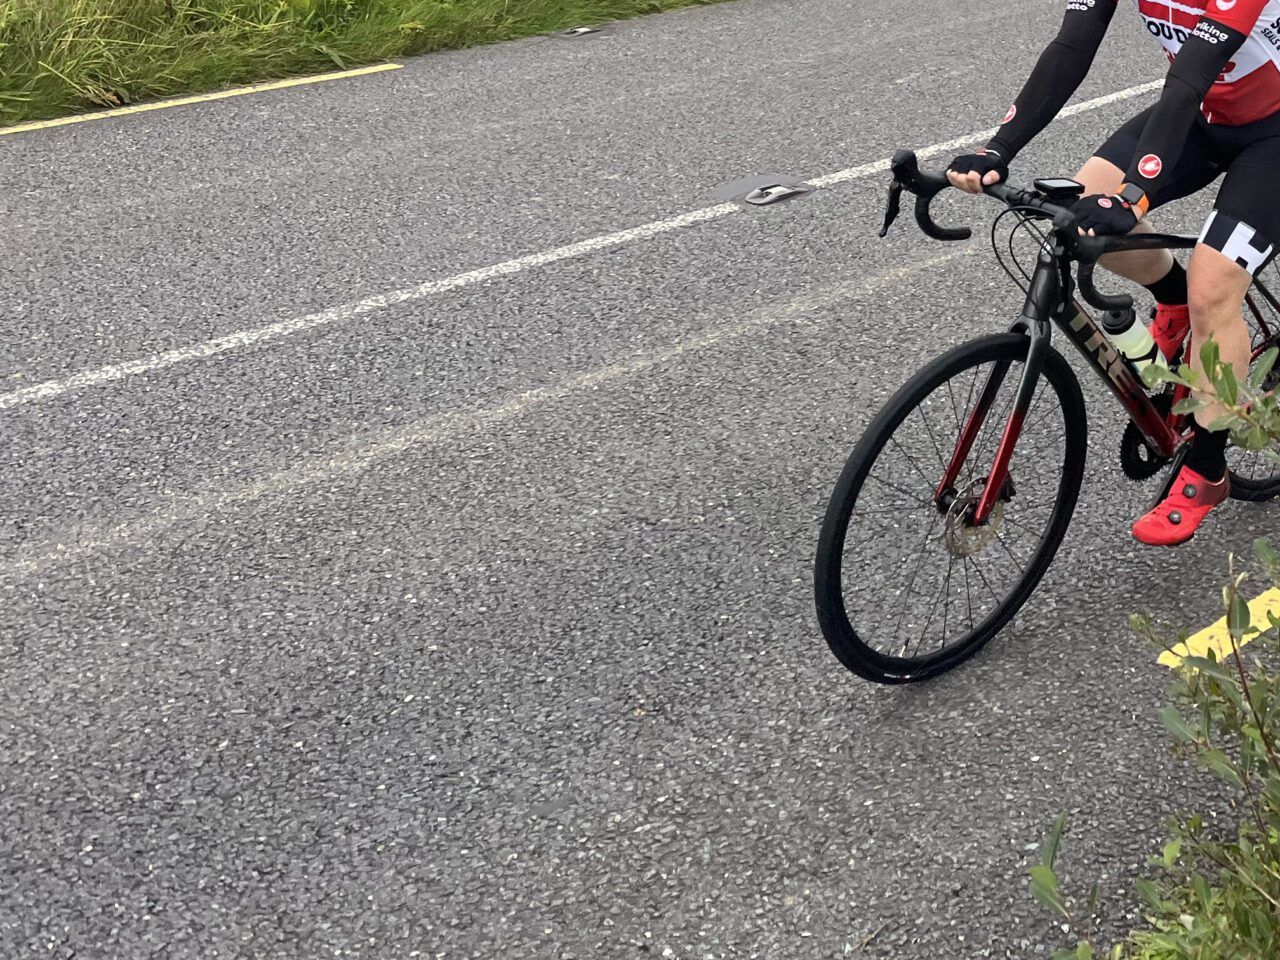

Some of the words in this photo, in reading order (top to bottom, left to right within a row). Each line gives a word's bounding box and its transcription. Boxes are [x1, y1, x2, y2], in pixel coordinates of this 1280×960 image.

[1066, 2, 1089, 11] otto
[1191, 28, 1218, 44] lotto
[1195, 21, 1229, 42] viking
[1260, 27, 1280, 46] SEALS
